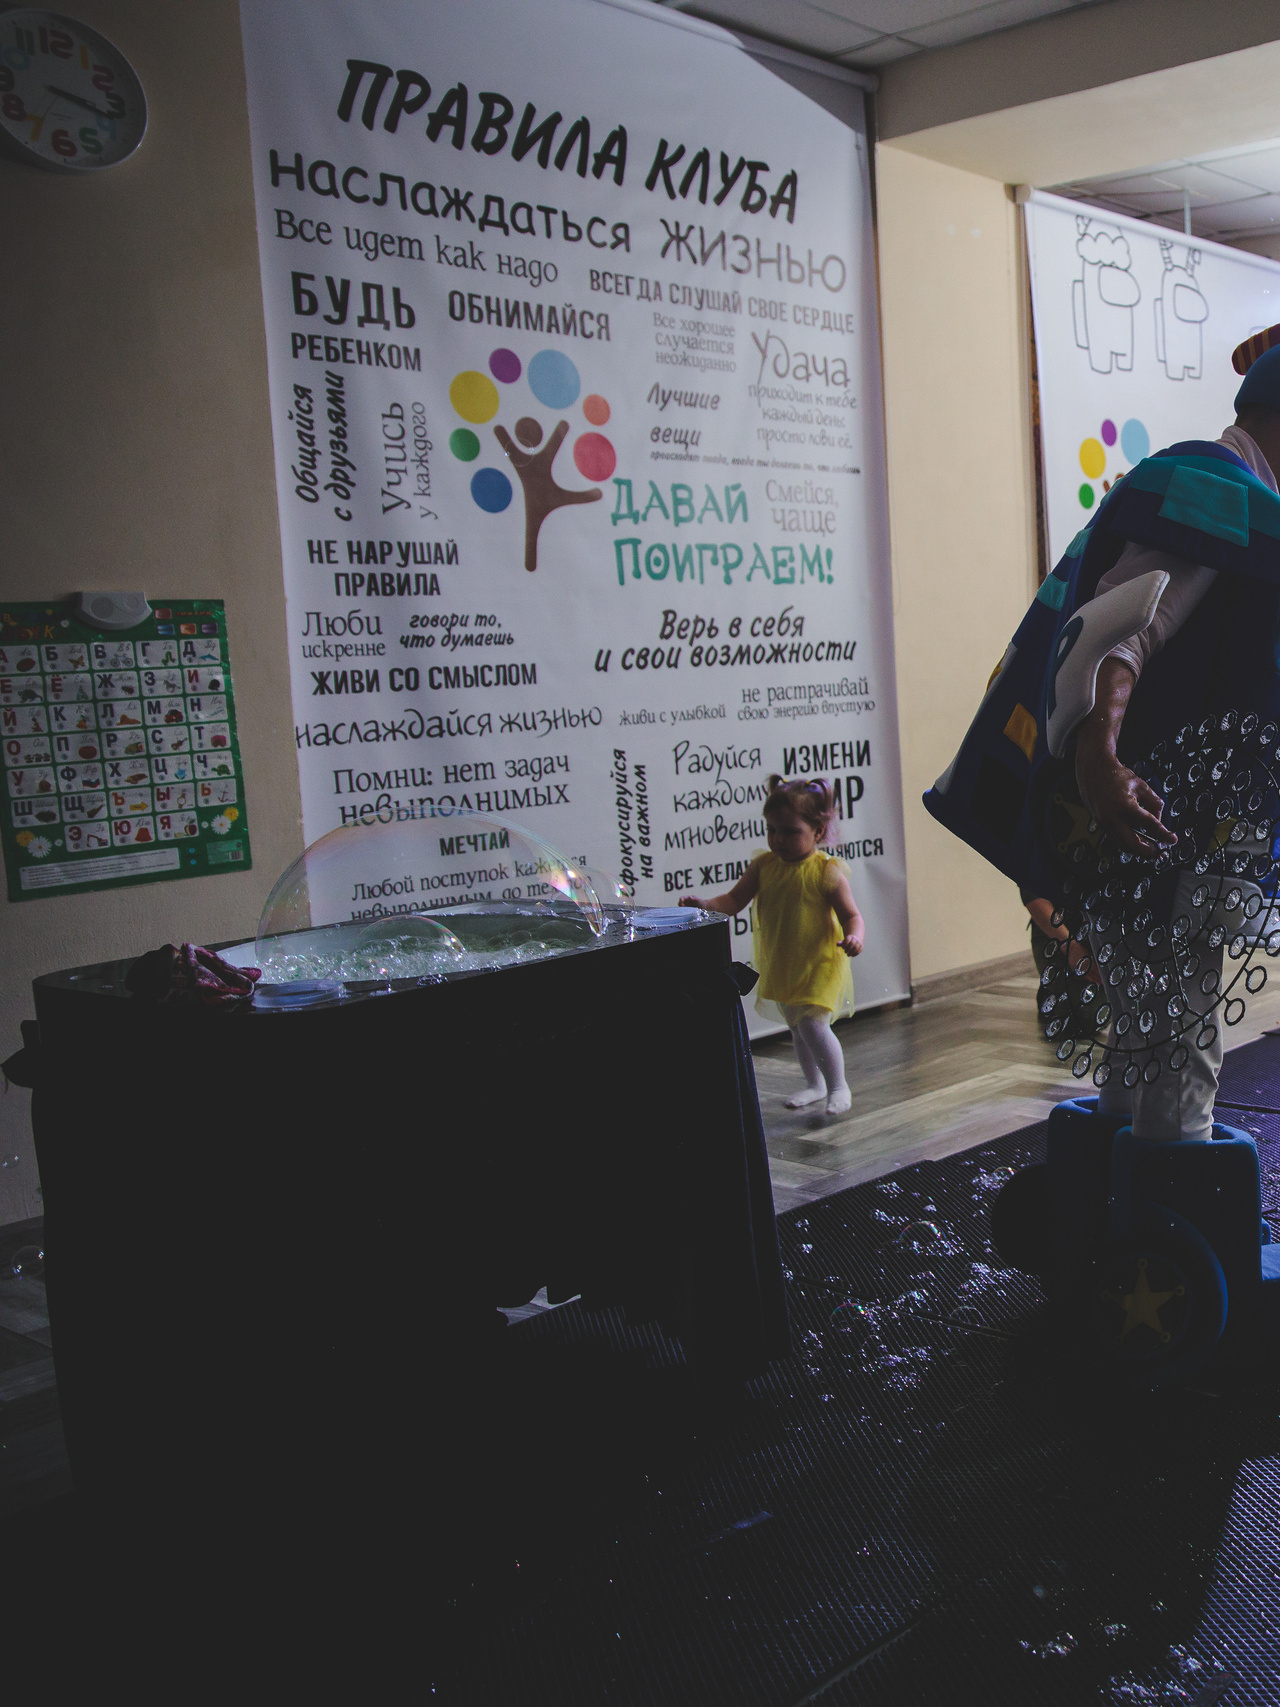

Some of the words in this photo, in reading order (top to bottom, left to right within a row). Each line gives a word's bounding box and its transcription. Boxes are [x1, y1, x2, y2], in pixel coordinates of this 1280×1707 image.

[337, 59, 628, 186] ПРАВИЛА
[645, 138, 799, 223] КЛУБА
[268, 149, 631, 253] наслаждаться
[274, 208, 332, 245] Все
[344, 225, 425, 262] идет
[434, 234, 487, 271] как
[497, 252, 558, 288] надо
[291, 270, 416, 331] БУДЬ
[448, 290, 611, 341] ОБНИМАЙСЯ
[589, 269, 663, 302] ВСЕГДА
[669, 282, 742, 314] СЛУШАЙ
[748, 296, 788, 322] СВОЕ
[793, 304, 855, 335] СЕРДЦЕ
[291, 332, 422, 372] РЕБЕНКОМ
[752, 329, 850, 388] Удача
[647, 382, 721, 411] Лучшие
[287, 383, 323, 503] Общайся
[323, 370, 357, 500] друзьями
[410, 401, 433, 497] каждого
[650, 426, 701, 450] вещи
[381, 402, 412, 515] Учись
[334, 506, 352, 522] с
[419, 505, 438, 520] у
[611, 477, 748, 527] ДАВАЙ
[771, 506, 837, 536] чаще
[307, 540, 339, 564] НЕ
[346, 538, 459, 568] НАРУШАЙ
[614, 537, 834, 586] ПОИГРАЕМ!
[334, 573, 441, 596] ПРАВИЛА
[302, 609, 383, 637] Люби
[399, 632, 435, 649] что
[440, 626, 515, 652] думаешь
[409, 612, 469, 631] говори
[474, 612, 502, 629] то,
[659, 608, 719, 647] Верь
[728, 617, 743, 638] в
[750, 605, 805, 638] себя
[302, 640, 386, 662] искренне
[594, 648, 612, 672] и
[621, 646, 682, 670] свои
[690, 640, 857, 667] возможности
[310, 669, 380, 696] ЖИВИ
[389, 666, 420, 692] СО
[428, 663, 537, 690] СМЫСЛОМ
[742, 686, 761, 703] не
[767, 676, 870, 706] растрачивай
[295, 708, 493, 749] наслаждайся
[499, 705, 603, 739] жизнью
[619, 709, 656, 727] живи
[659, 709, 667, 723] с
[670, 704, 727, 726] улыбкой
[737, 704, 769, 722] свою
[773, 702, 820, 721] энергию
[821, 698, 876, 718] впустую
[332, 767, 433, 796] Помни:
[443, 760, 496, 785] нет
[504, 755, 571, 783] задач
[672, 740, 762, 786] Радуйся
[783, 740, 871, 775] ИЗМЕНИ
[339, 783, 571, 828] невыполнимых
[636, 764, 652, 847] важном
[439, 828, 511, 857] МЕЧТАЙ
[664, 815, 768, 851] мгновени
[351, 874, 416, 901] Любой
[420, 862, 509, 892] поступок
[640, 855, 653, 878] на
[664, 868, 693, 892] ВСЕ
